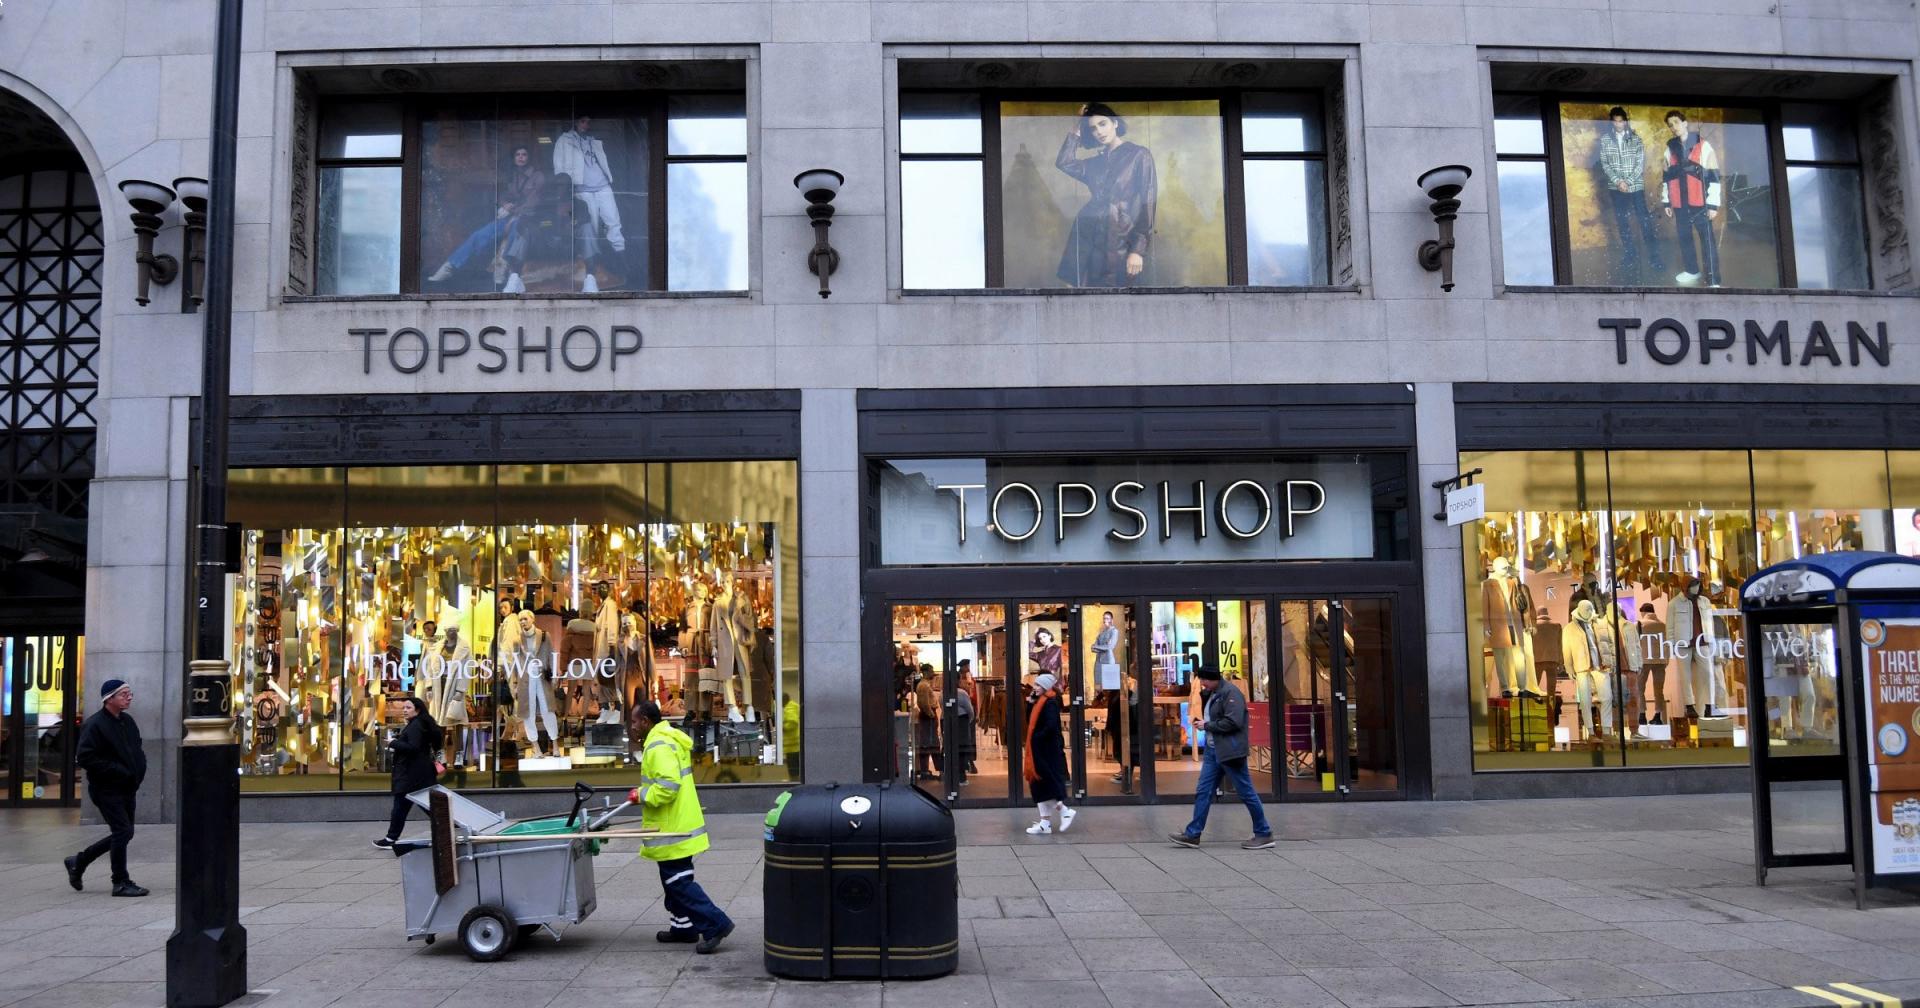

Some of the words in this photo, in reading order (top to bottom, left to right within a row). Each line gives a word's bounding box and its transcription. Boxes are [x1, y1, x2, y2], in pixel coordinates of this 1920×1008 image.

[348, 325, 643, 374] TOPSHOP
[1599, 317, 1890, 367] TOPMAN
[937, 479, 1326, 543] TOPSHOP
[1449, 497, 1477, 513] TOPSHOP
[199, 597, 208, 609] 2
[1640, 632, 1689, 660] The
[1696, 632, 1745, 660] One
[1764, 631, 1803, 657] We
[366, 652, 414, 681] The
[422, 652, 493, 681] Ones
[500, 651, 544, 681] We
[551, 651, 617, 681] Love
[1879, 675, 1887, 685] IS
[1889, 674, 1903, 685] THE
